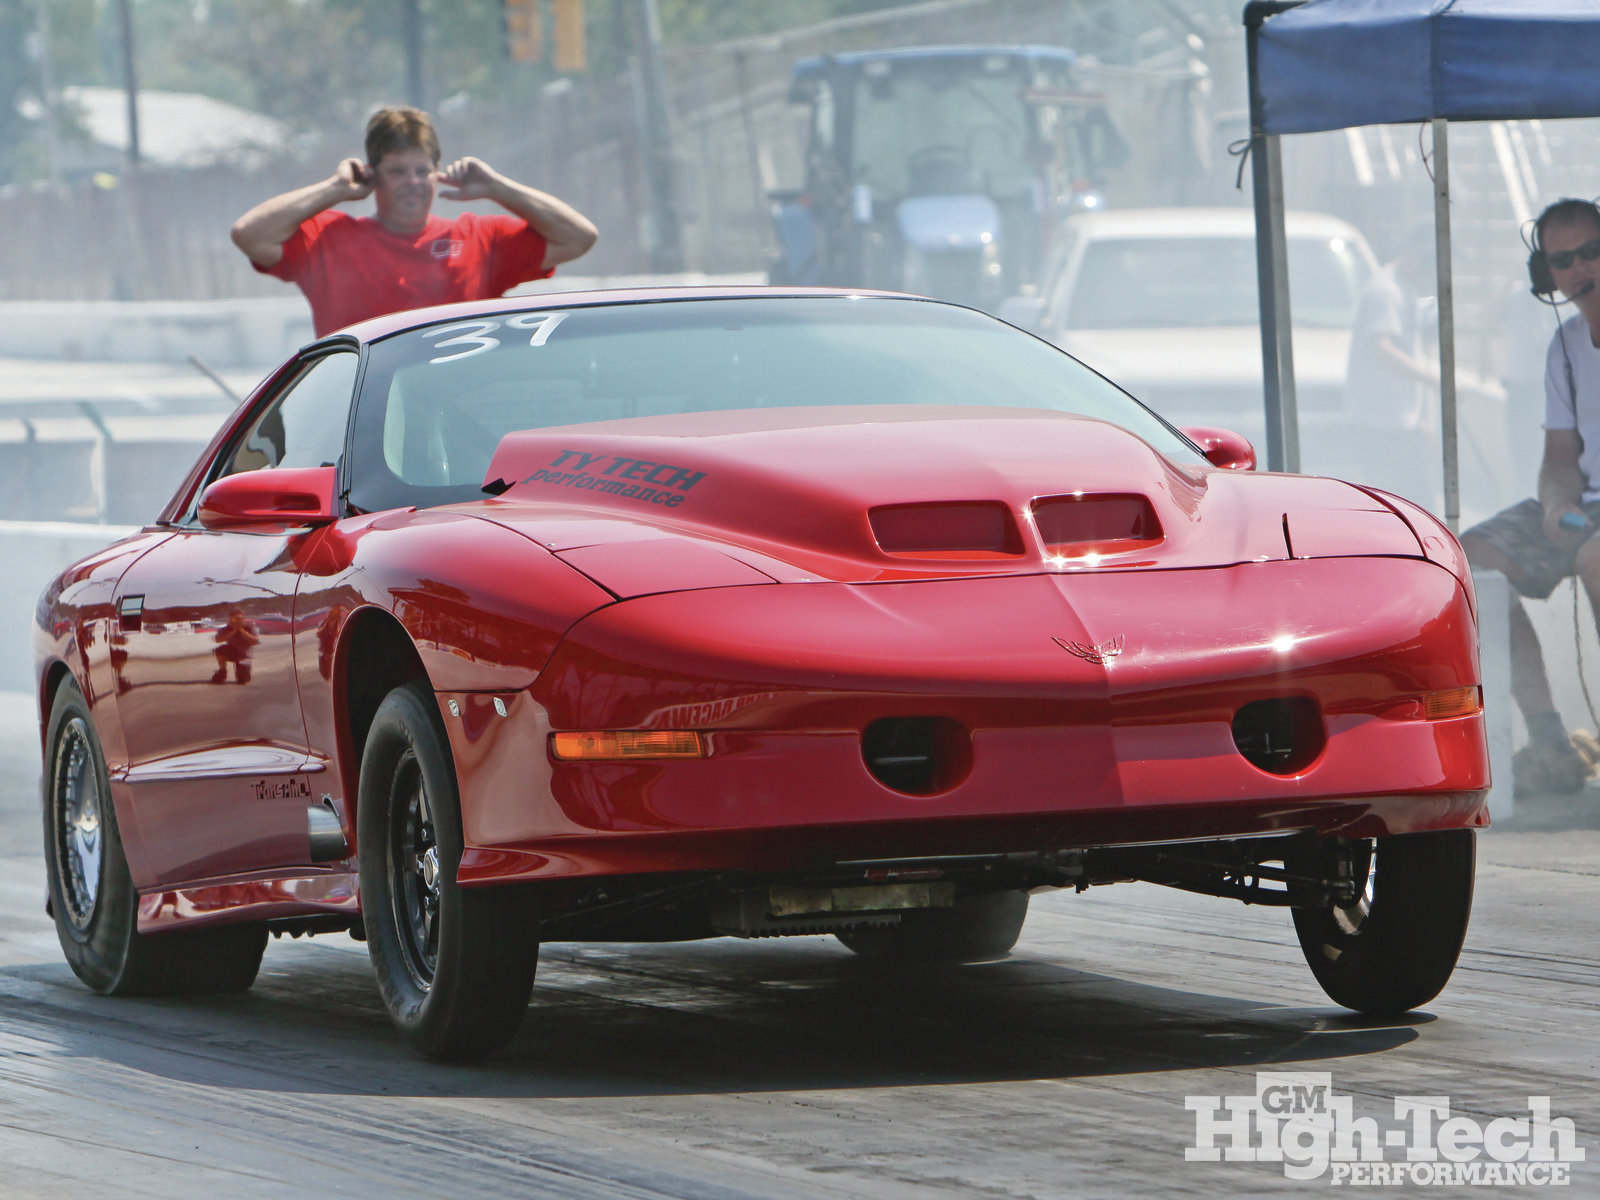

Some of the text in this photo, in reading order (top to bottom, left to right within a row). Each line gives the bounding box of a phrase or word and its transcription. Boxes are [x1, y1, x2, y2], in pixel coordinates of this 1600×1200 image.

[421, 312, 570, 364] 39
[520, 468, 685, 508] performance
[549, 449, 707, 492] TY TECH
